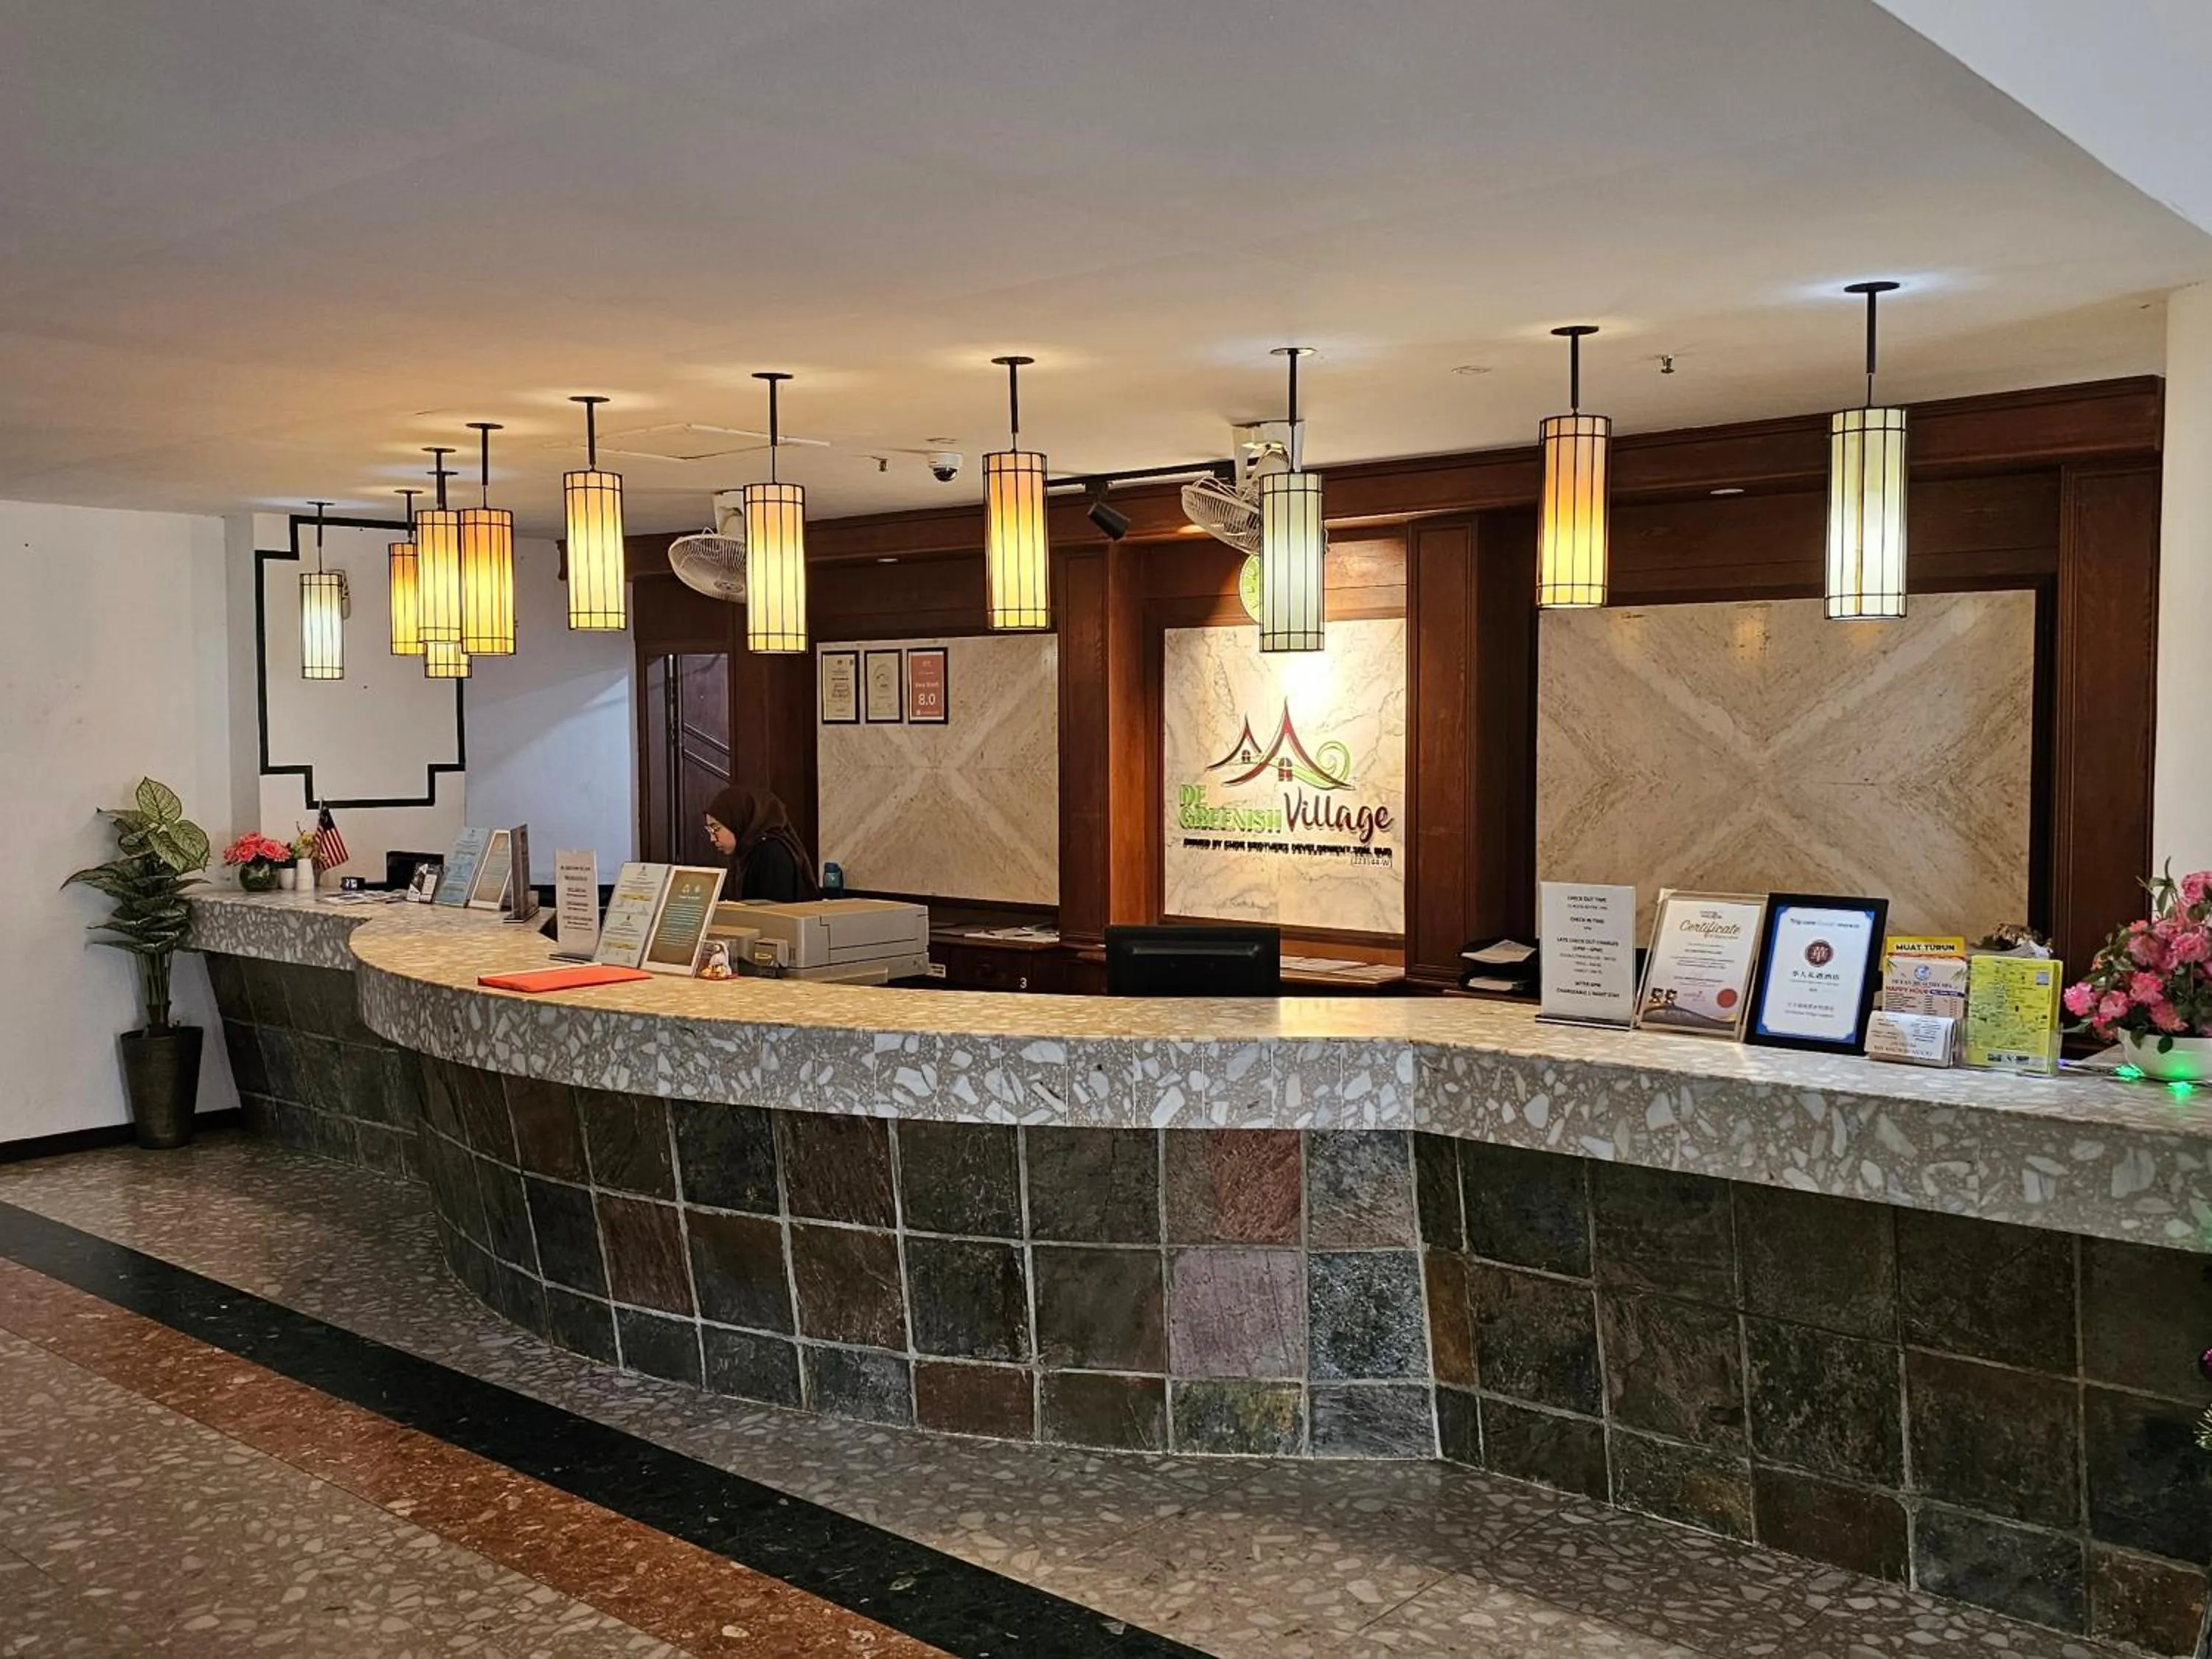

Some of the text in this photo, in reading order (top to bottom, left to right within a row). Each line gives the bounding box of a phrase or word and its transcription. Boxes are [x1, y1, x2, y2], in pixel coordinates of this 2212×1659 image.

[918, 693, 936, 706] 8.0
[1180, 785, 1207, 806] DE
[1180, 787, 1394, 844] GREENISH Village
[1211, 839, 1222, 849] BY
[1679, 919, 1741, 935] Certificate
[1020, 977, 1027, 989] 3
